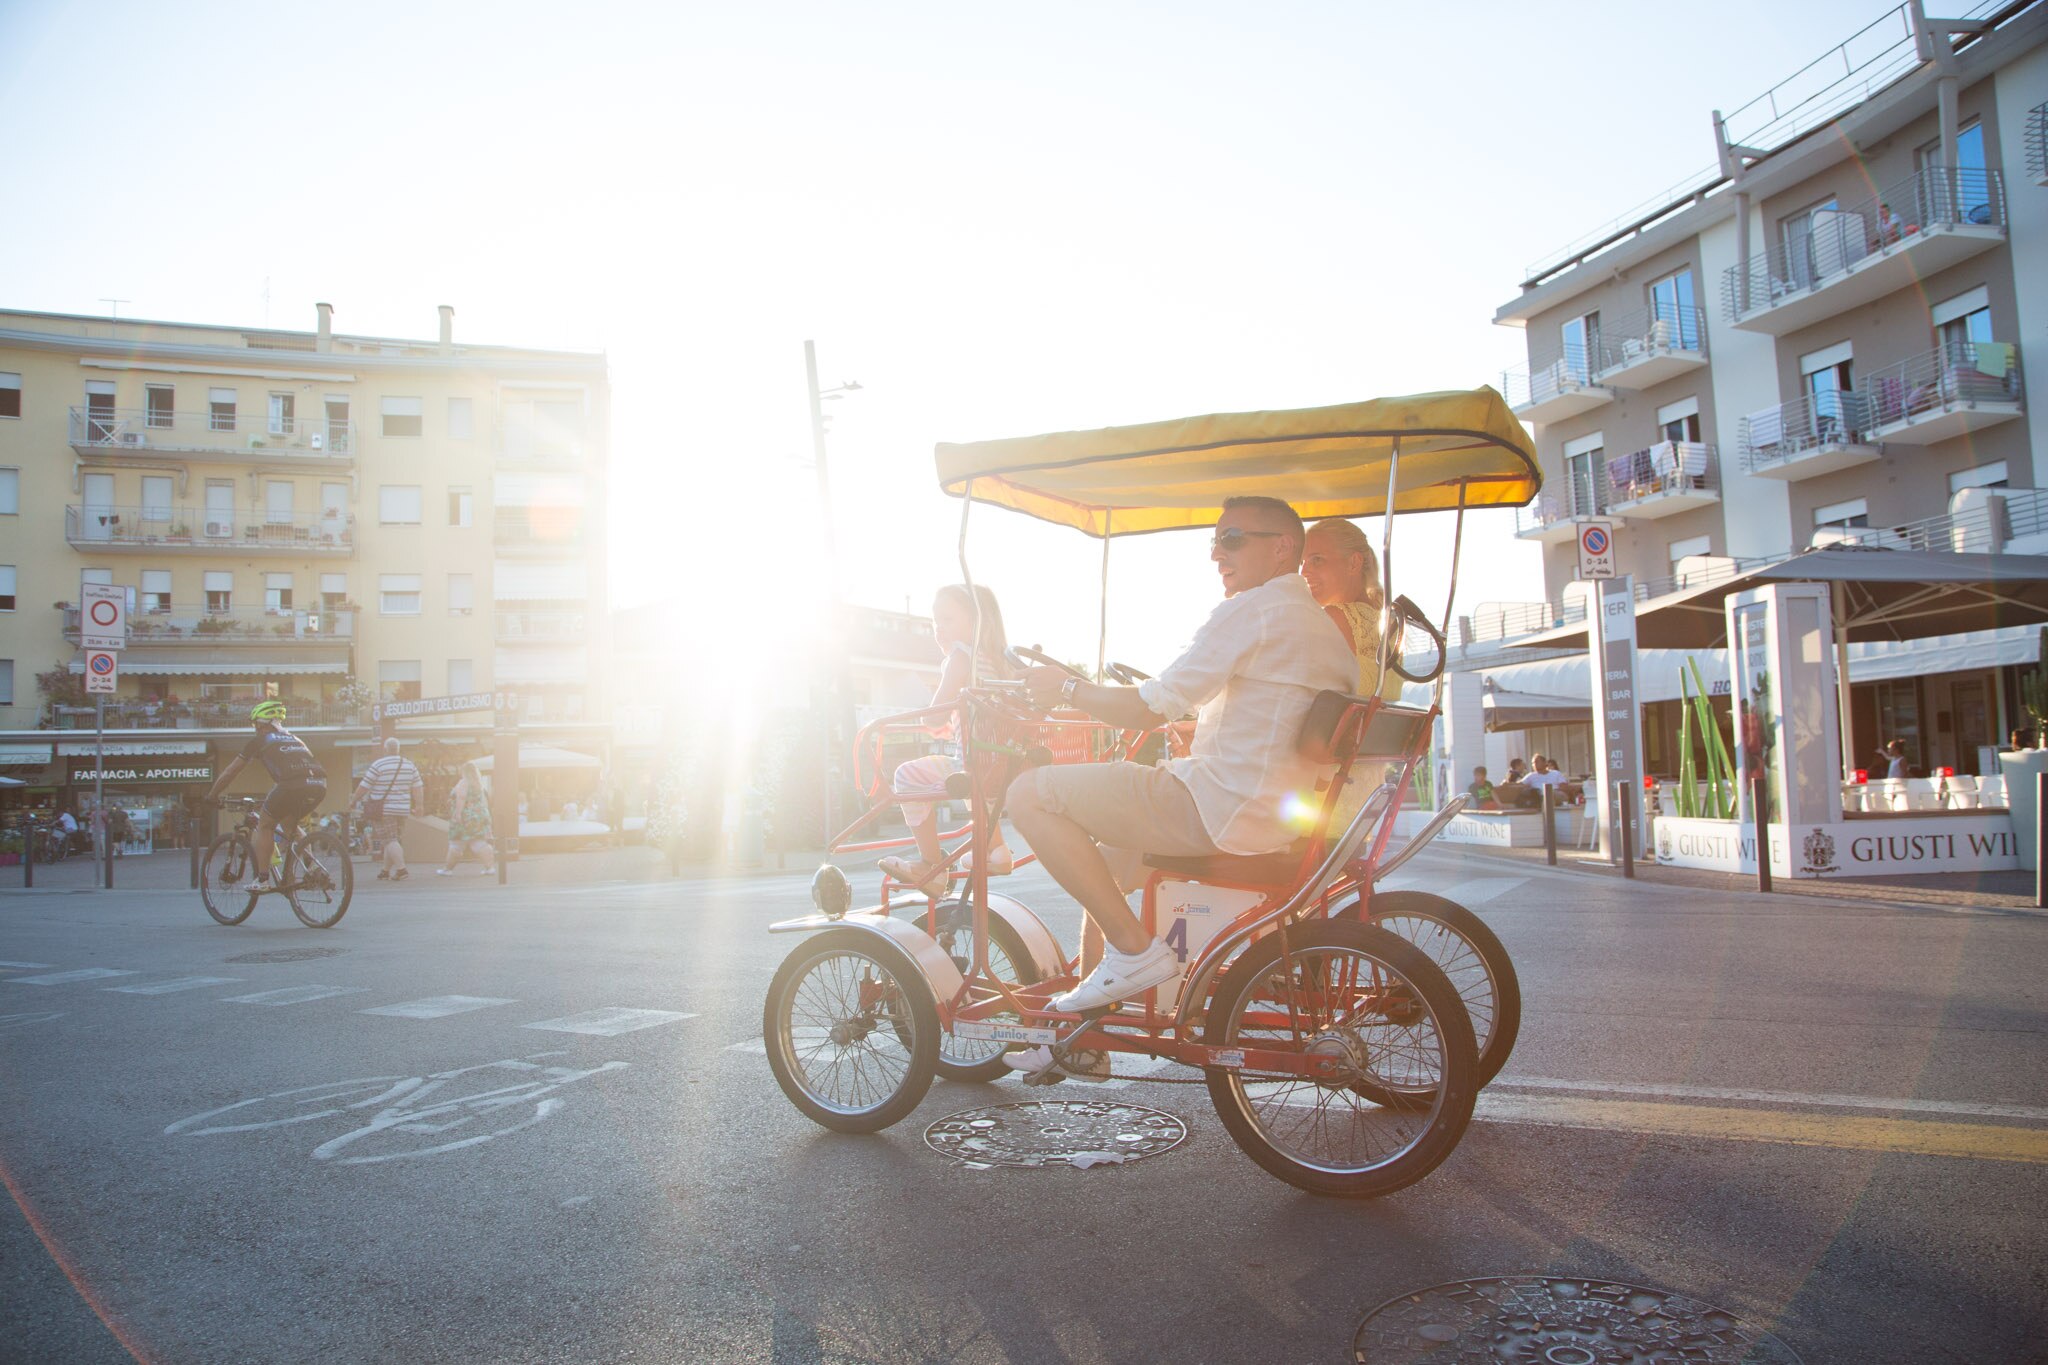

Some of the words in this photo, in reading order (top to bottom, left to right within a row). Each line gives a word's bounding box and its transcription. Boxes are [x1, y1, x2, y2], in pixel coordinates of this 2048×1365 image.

[1603, 601, 1626, 617] TER
[1606, 670, 1629, 681] ERIA
[1612, 689, 1631, 701] BAR
[1712, 680, 1731, 694] HO
[384, 703, 412, 716] JESOLO
[437, 698, 452, 711] DEL
[453, 694, 491, 709] CICLISMO
[74, 769, 137, 780] FARMACIA
[146, 768, 210, 778] APOTHEKE
[1448, 820, 1478, 836] GIUSTI
[1480, 822, 1505, 839] WINE
[1679, 834, 1729, 859] GIUSTI
[1734, 837, 1781, 864] WIE
[1851, 833, 1956, 862] GIUSTI
[1165, 918, 1188, 963] 4
